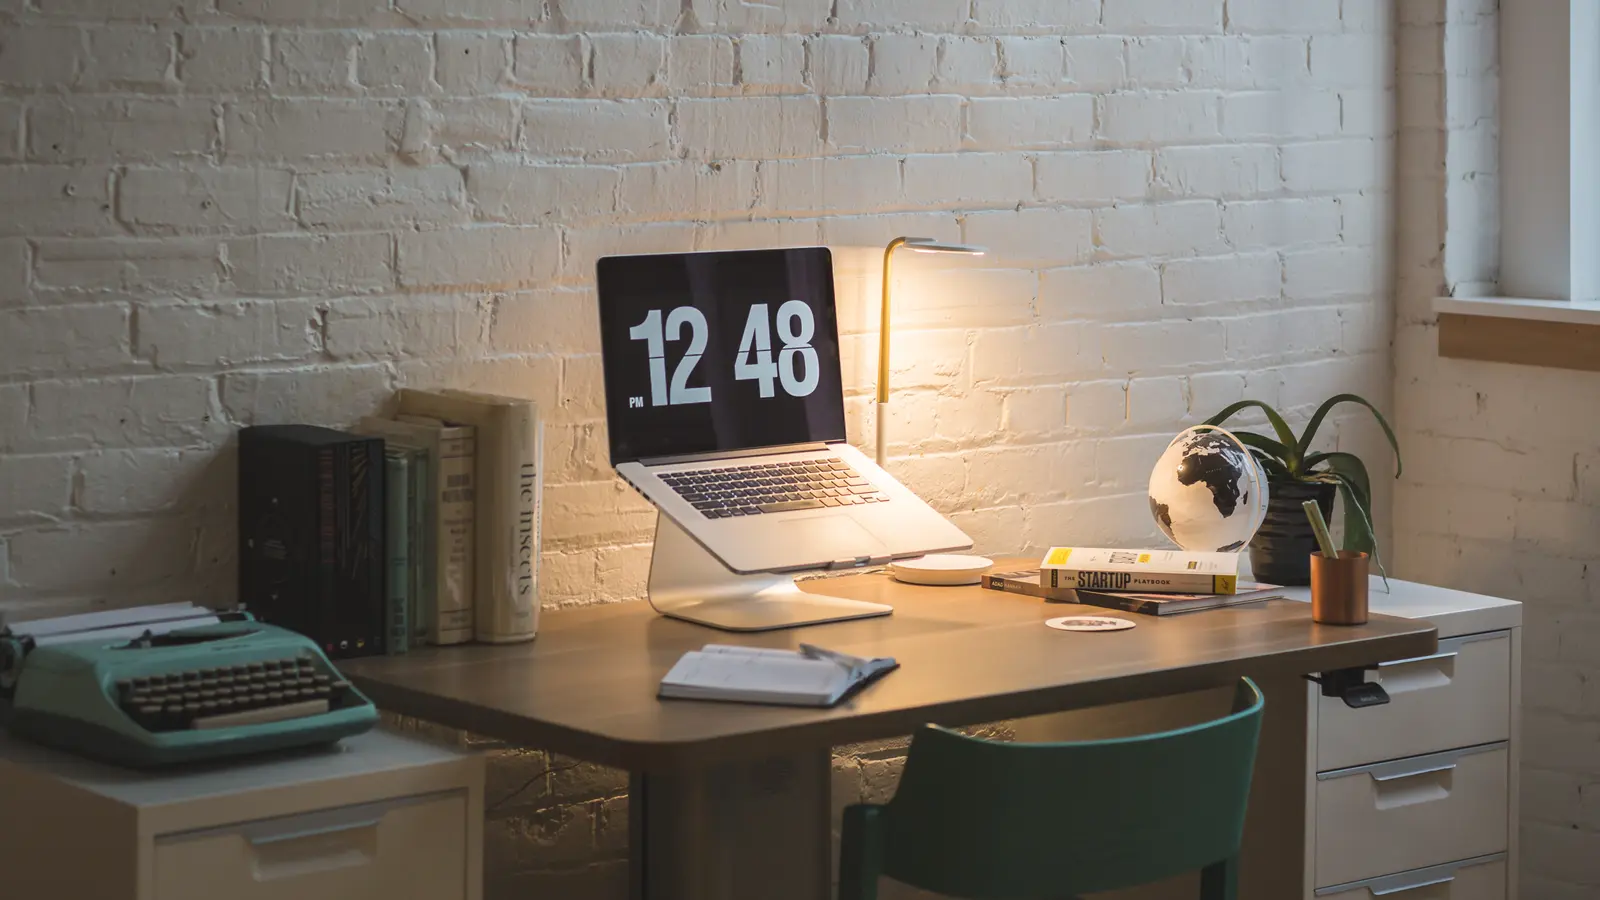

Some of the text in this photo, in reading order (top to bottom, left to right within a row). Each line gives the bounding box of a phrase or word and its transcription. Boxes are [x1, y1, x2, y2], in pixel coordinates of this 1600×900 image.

[629, 300, 820, 406] 12 48
[629, 396, 644, 408] PM
[520, 463, 536, 502] the
[519, 510, 534, 595] insects
[1078, 571, 1131, 589] STARTUP
